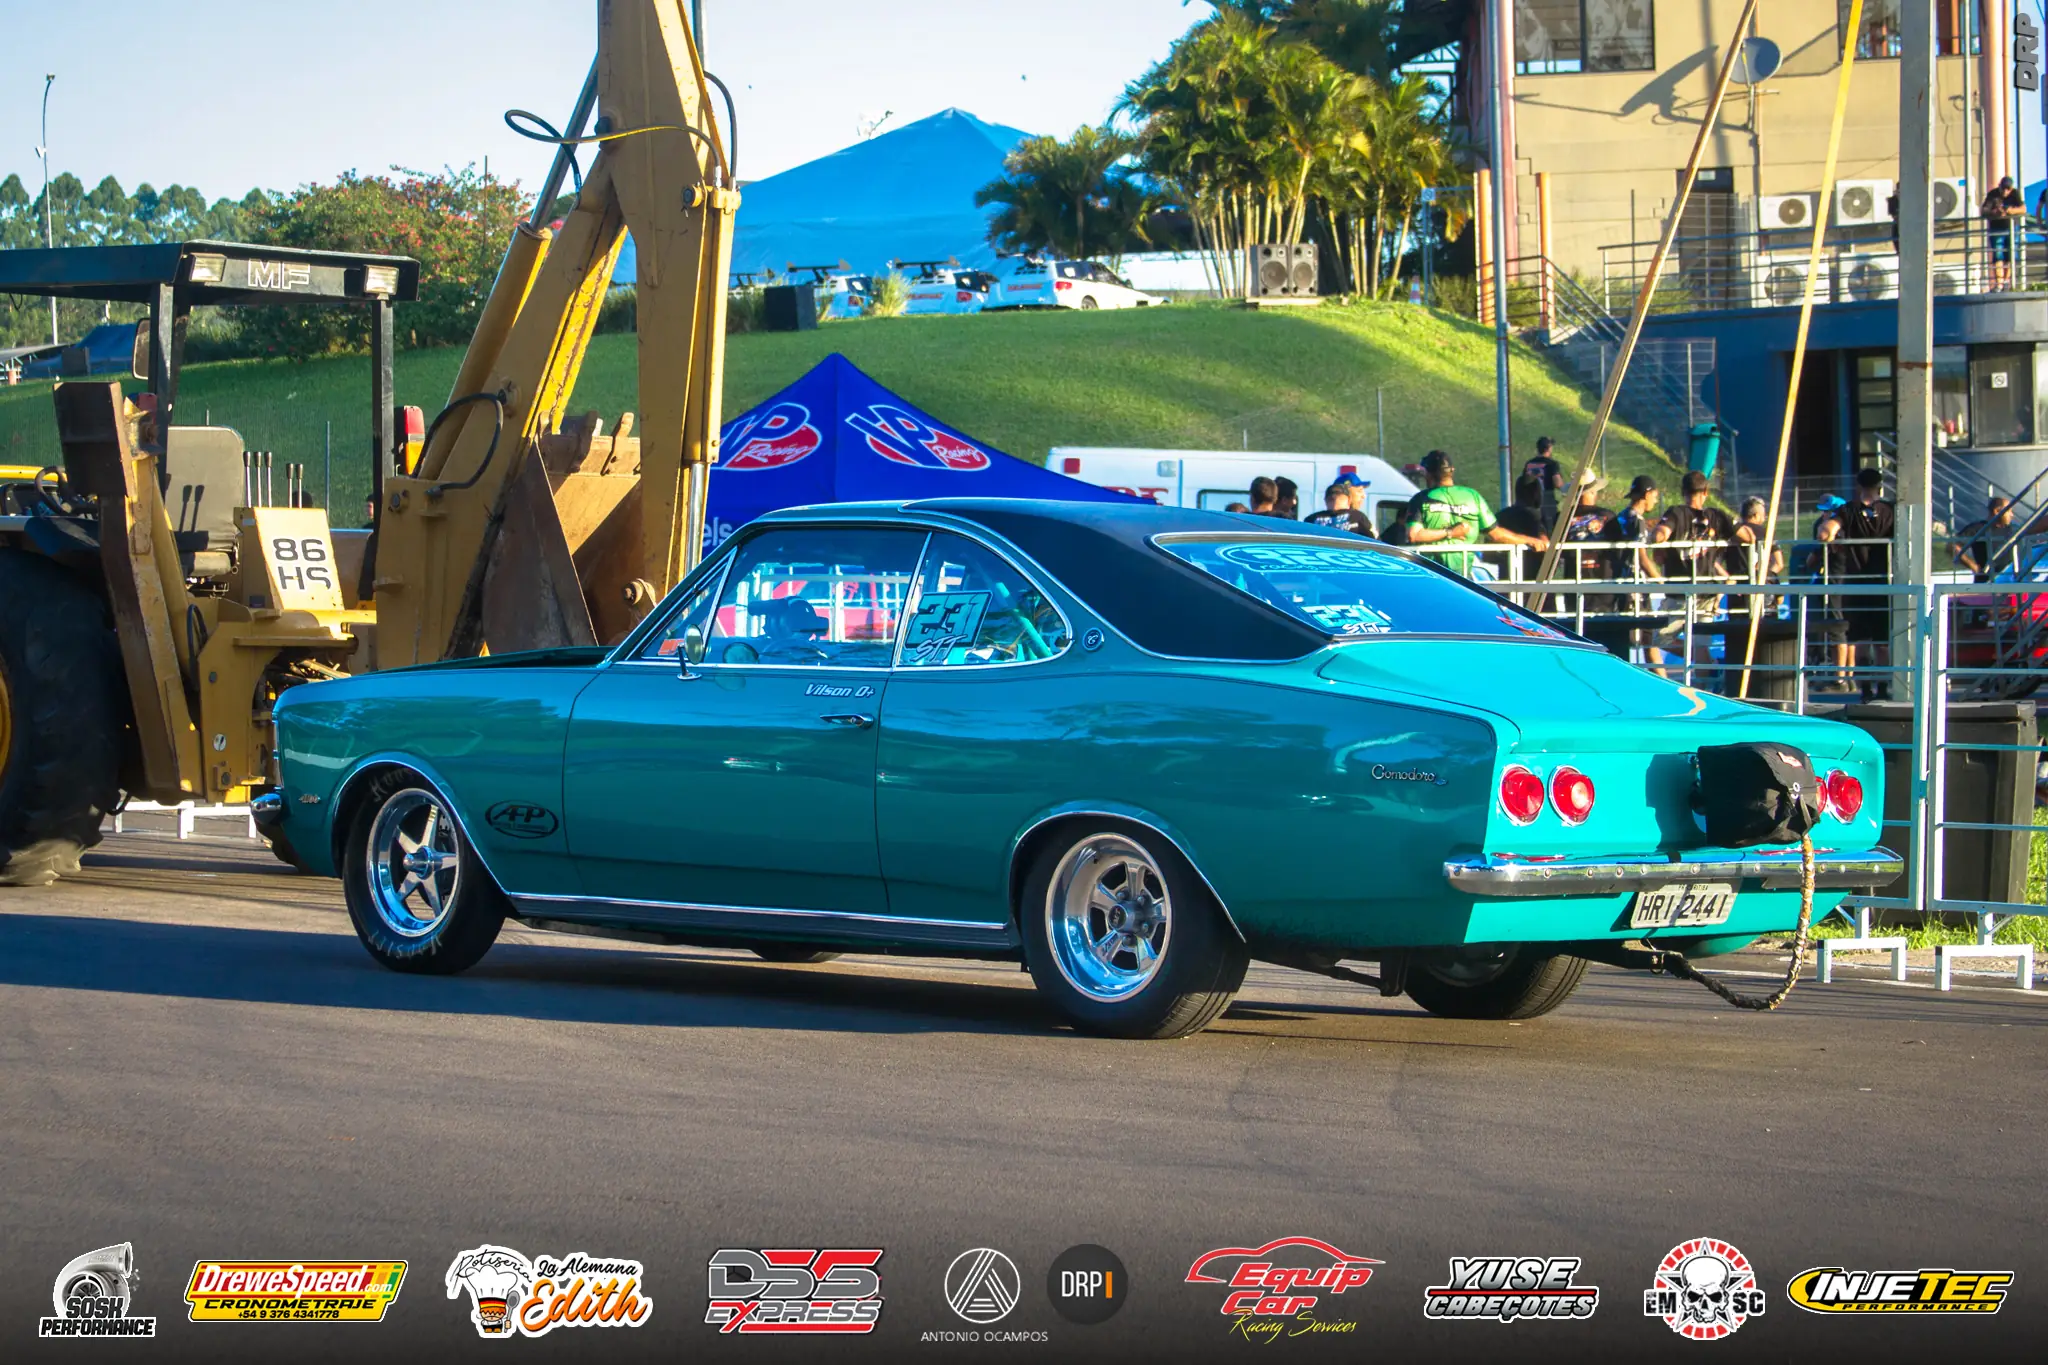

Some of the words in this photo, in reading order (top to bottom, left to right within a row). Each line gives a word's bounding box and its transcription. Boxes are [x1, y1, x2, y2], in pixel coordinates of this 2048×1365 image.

[248, 258, 311, 289] MF
[845, 404, 950, 468] VP
[737, 441, 809, 463] Racing
[932, 444, 982, 465] Racing
[703, 517, 733, 546] els
[273, 538, 326, 561] 86
[278, 566, 331, 590] HS
[906, 592, 990, 645] 231
[909, 634, 968, 662] STT
[805, 683, 853, 697] Vilson
[1371, 764, 1435, 781] Comodoro
